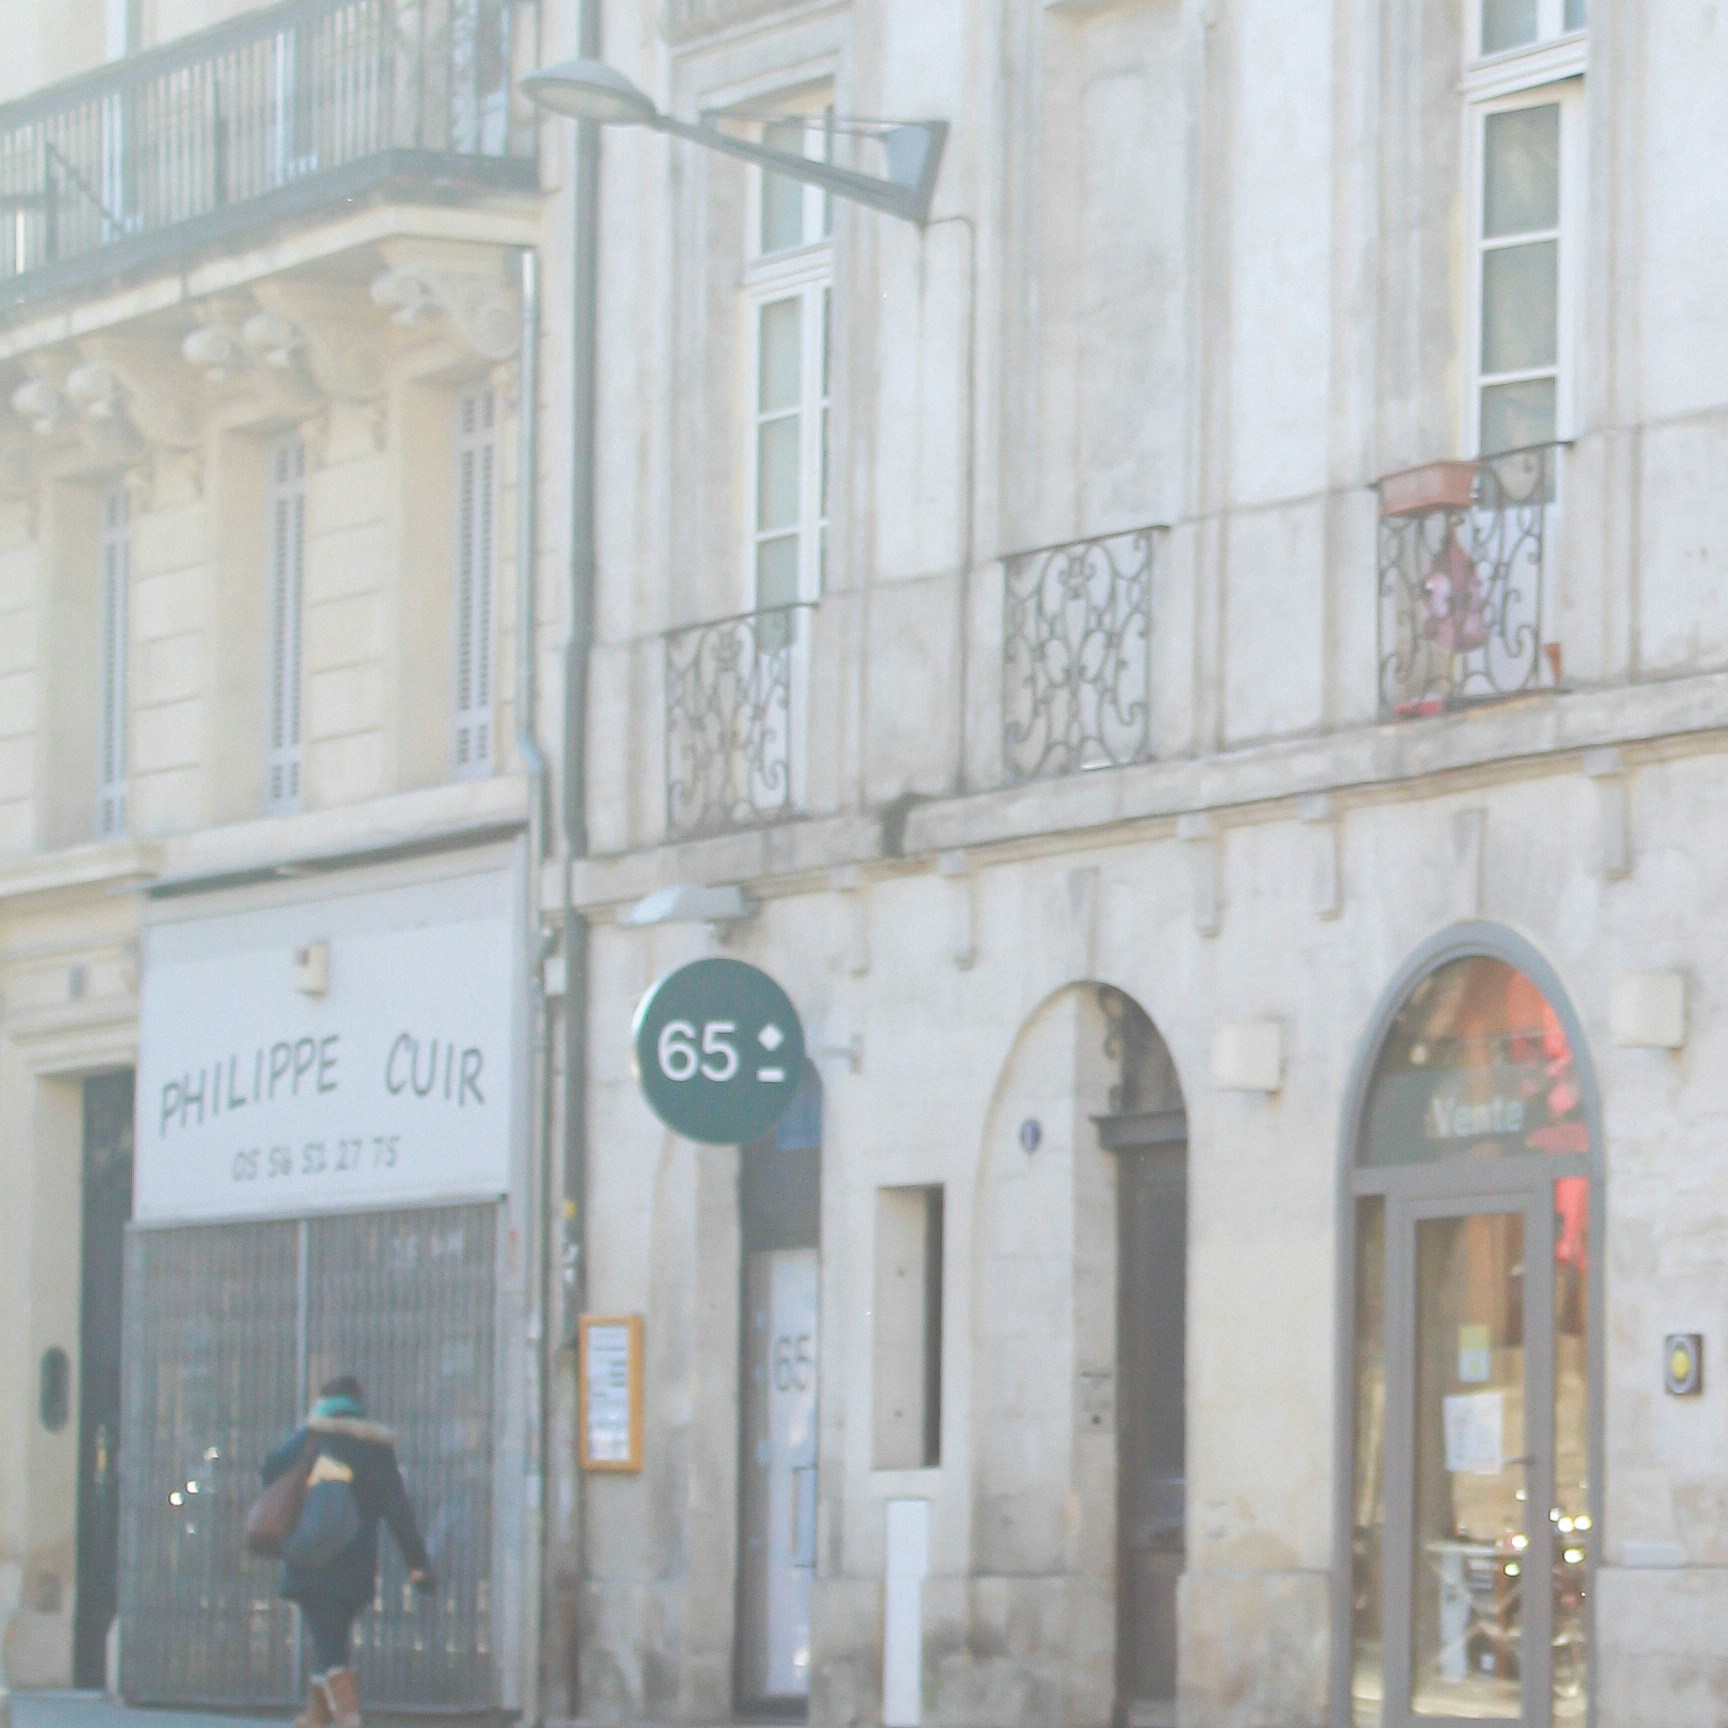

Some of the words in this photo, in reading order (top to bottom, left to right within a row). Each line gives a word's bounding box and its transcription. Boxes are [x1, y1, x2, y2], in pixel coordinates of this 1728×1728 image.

[657, 1018, 741, 1083] 65
[158, 1033, 340, 1138] PHILIPPE
[383, 1032, 486, 1108] CUIR
[1431, 1093, 1525, 1138] Vente
